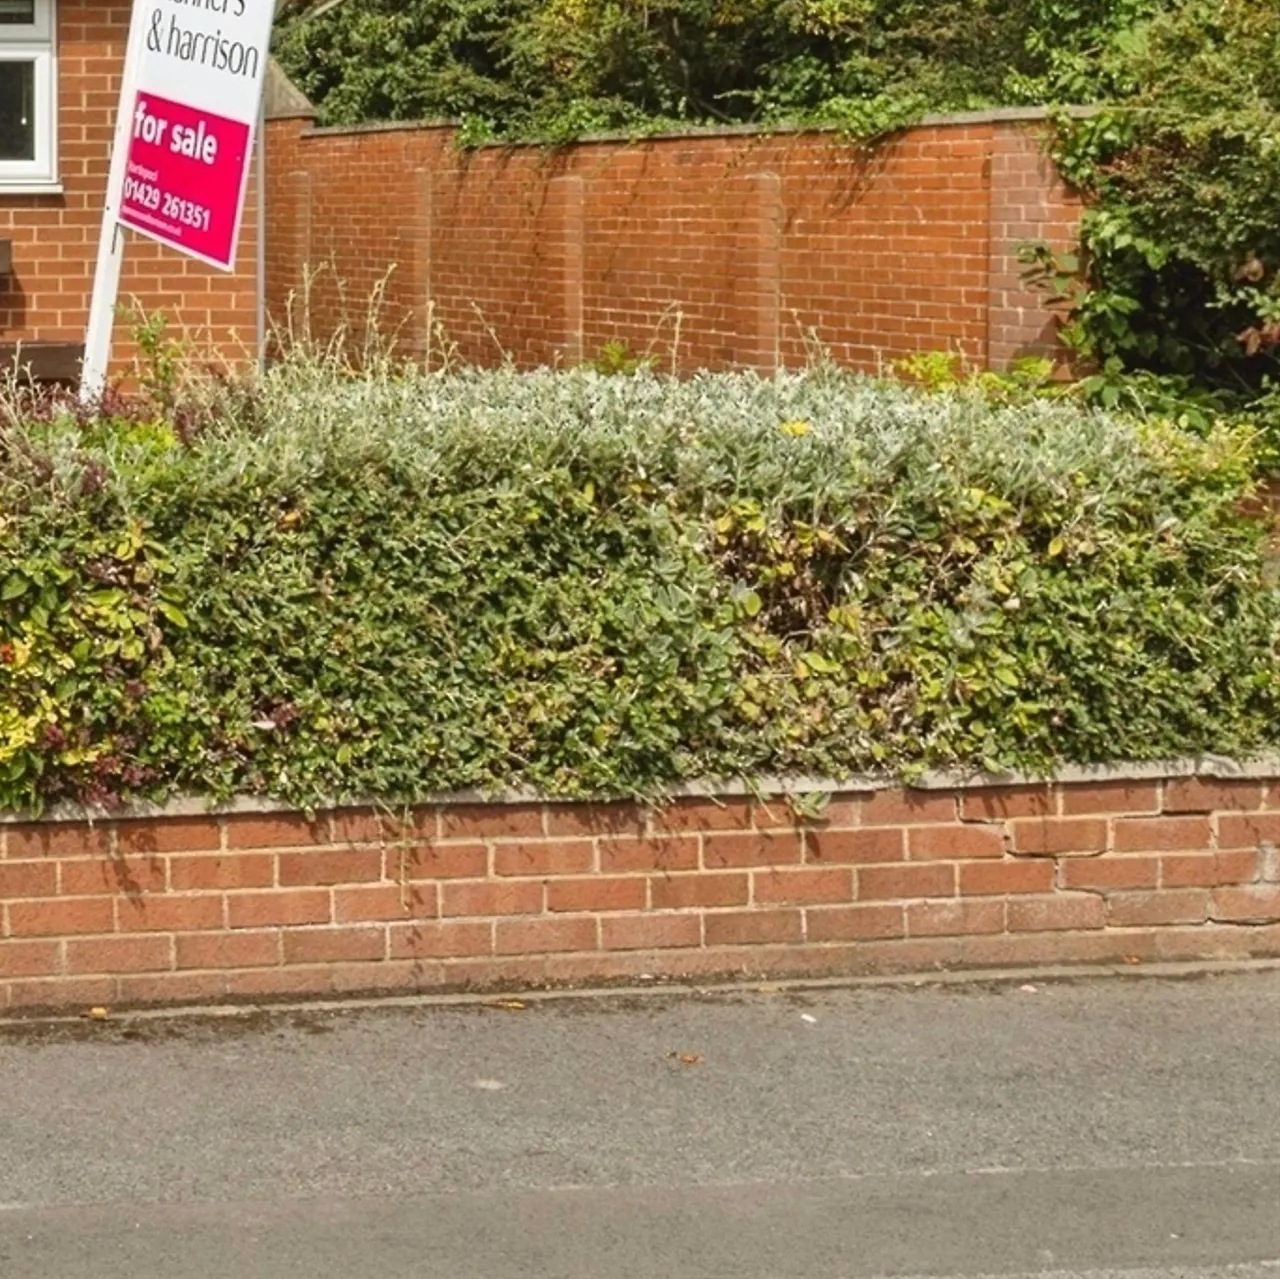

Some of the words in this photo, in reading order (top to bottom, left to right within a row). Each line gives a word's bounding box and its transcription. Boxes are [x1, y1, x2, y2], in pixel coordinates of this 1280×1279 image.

[147, 8, 162, 53] &
[167, 14, 259, 78] harrison
[134, 101, 168, 146] for
[170, 120, 218, 165] sale
[124, 177, 161, 210] 01429
[161, 192, 211, 232] 261351
